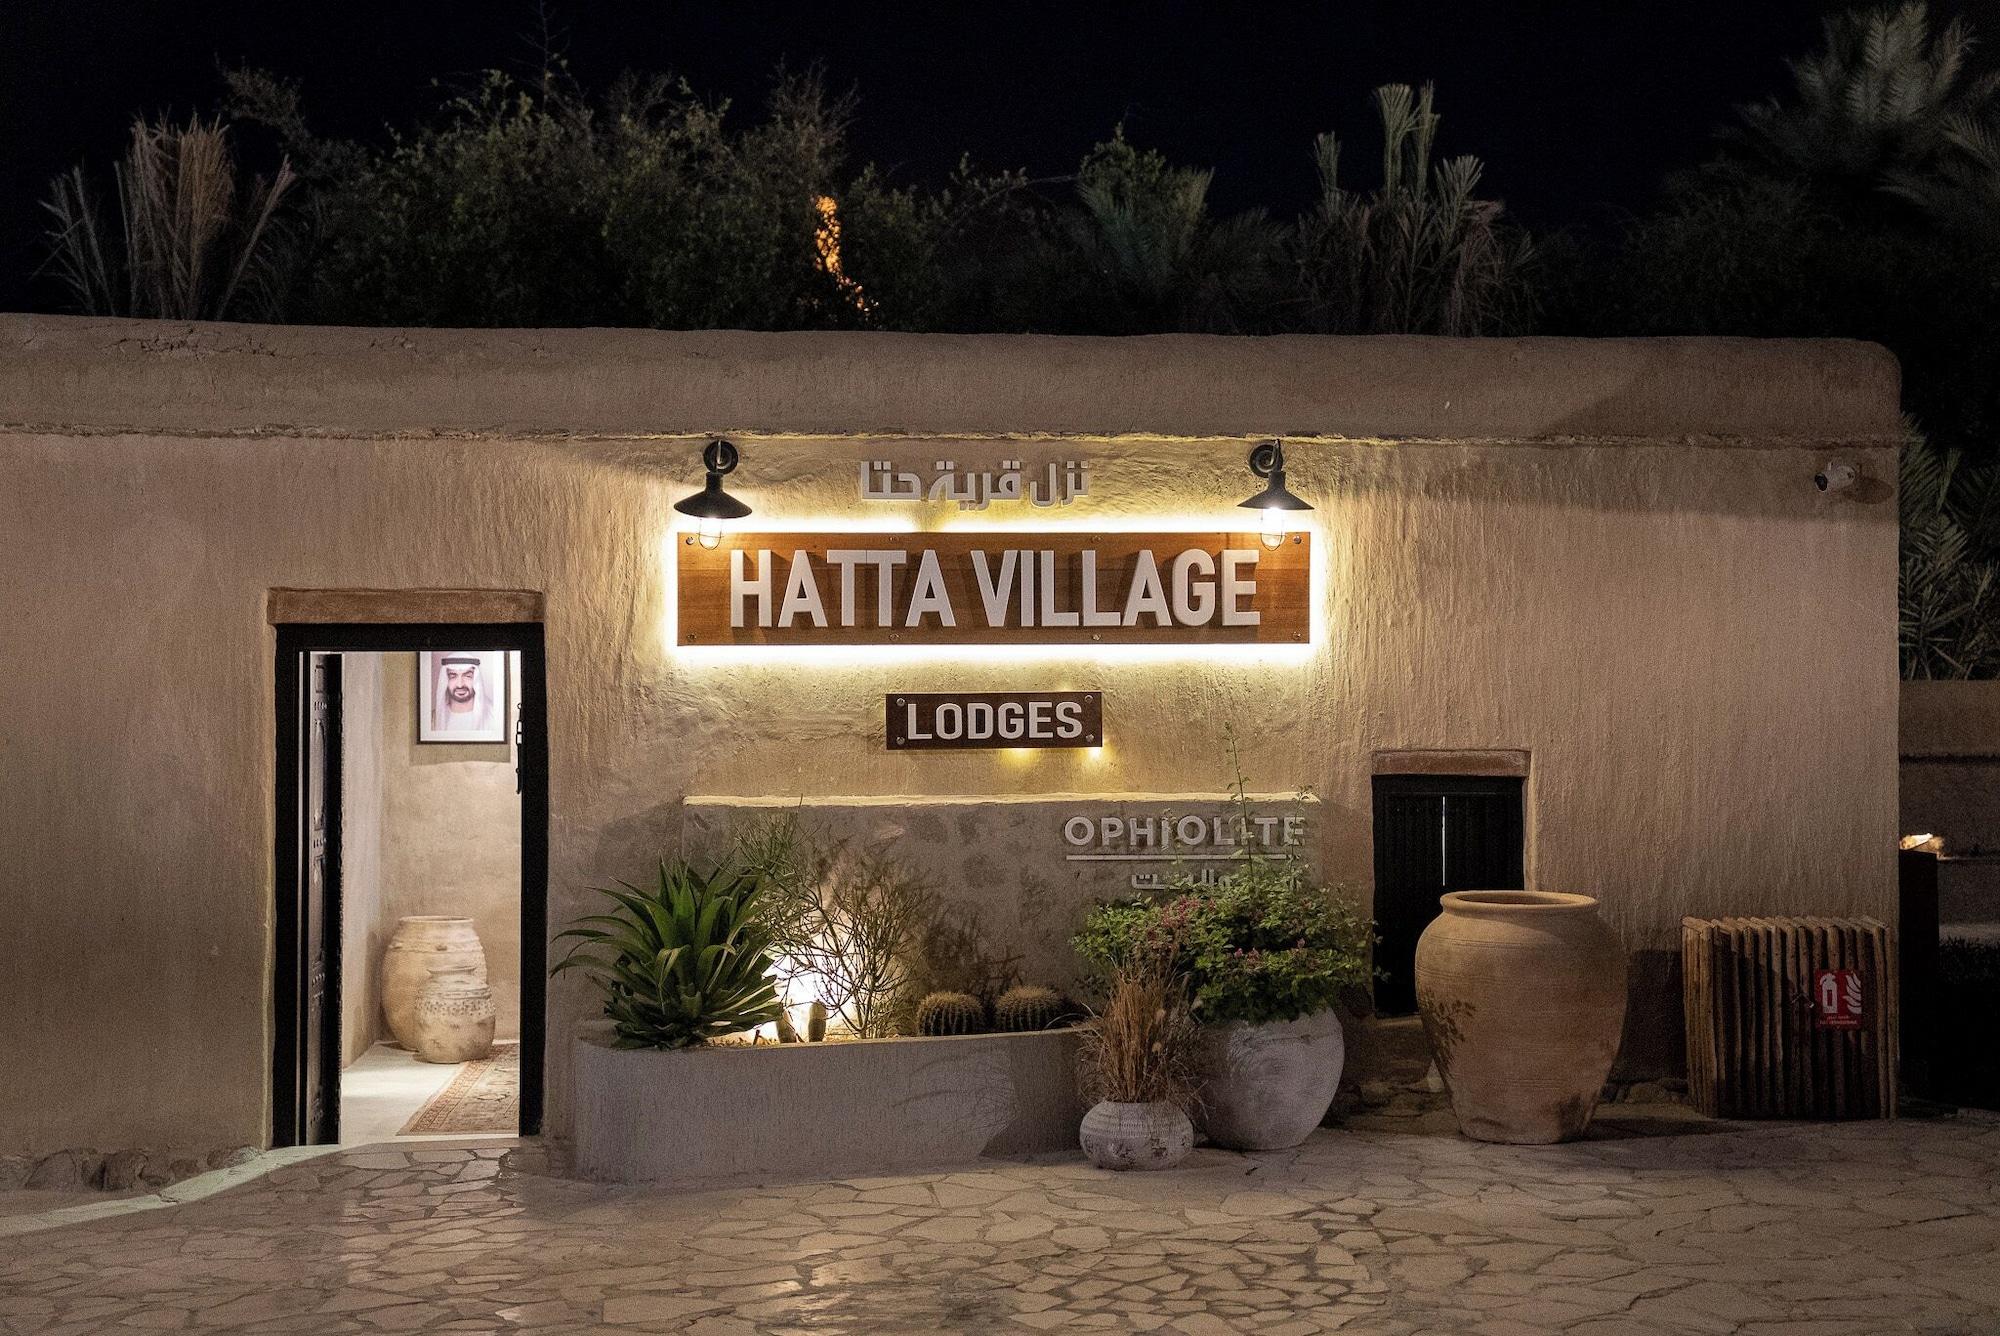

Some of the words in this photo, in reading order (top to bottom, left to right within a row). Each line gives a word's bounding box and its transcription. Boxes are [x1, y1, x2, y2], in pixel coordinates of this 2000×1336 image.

[860, 460, 922, 500] حتا
[928, 460, 1022, 511] قرية
[1030, 460, 1089, 508] نزل
[730, 549, 957, 628] HATTA
[970, 548, 1261, 627] VILLAGE
[907, 701, 1083, 740] LODGES
